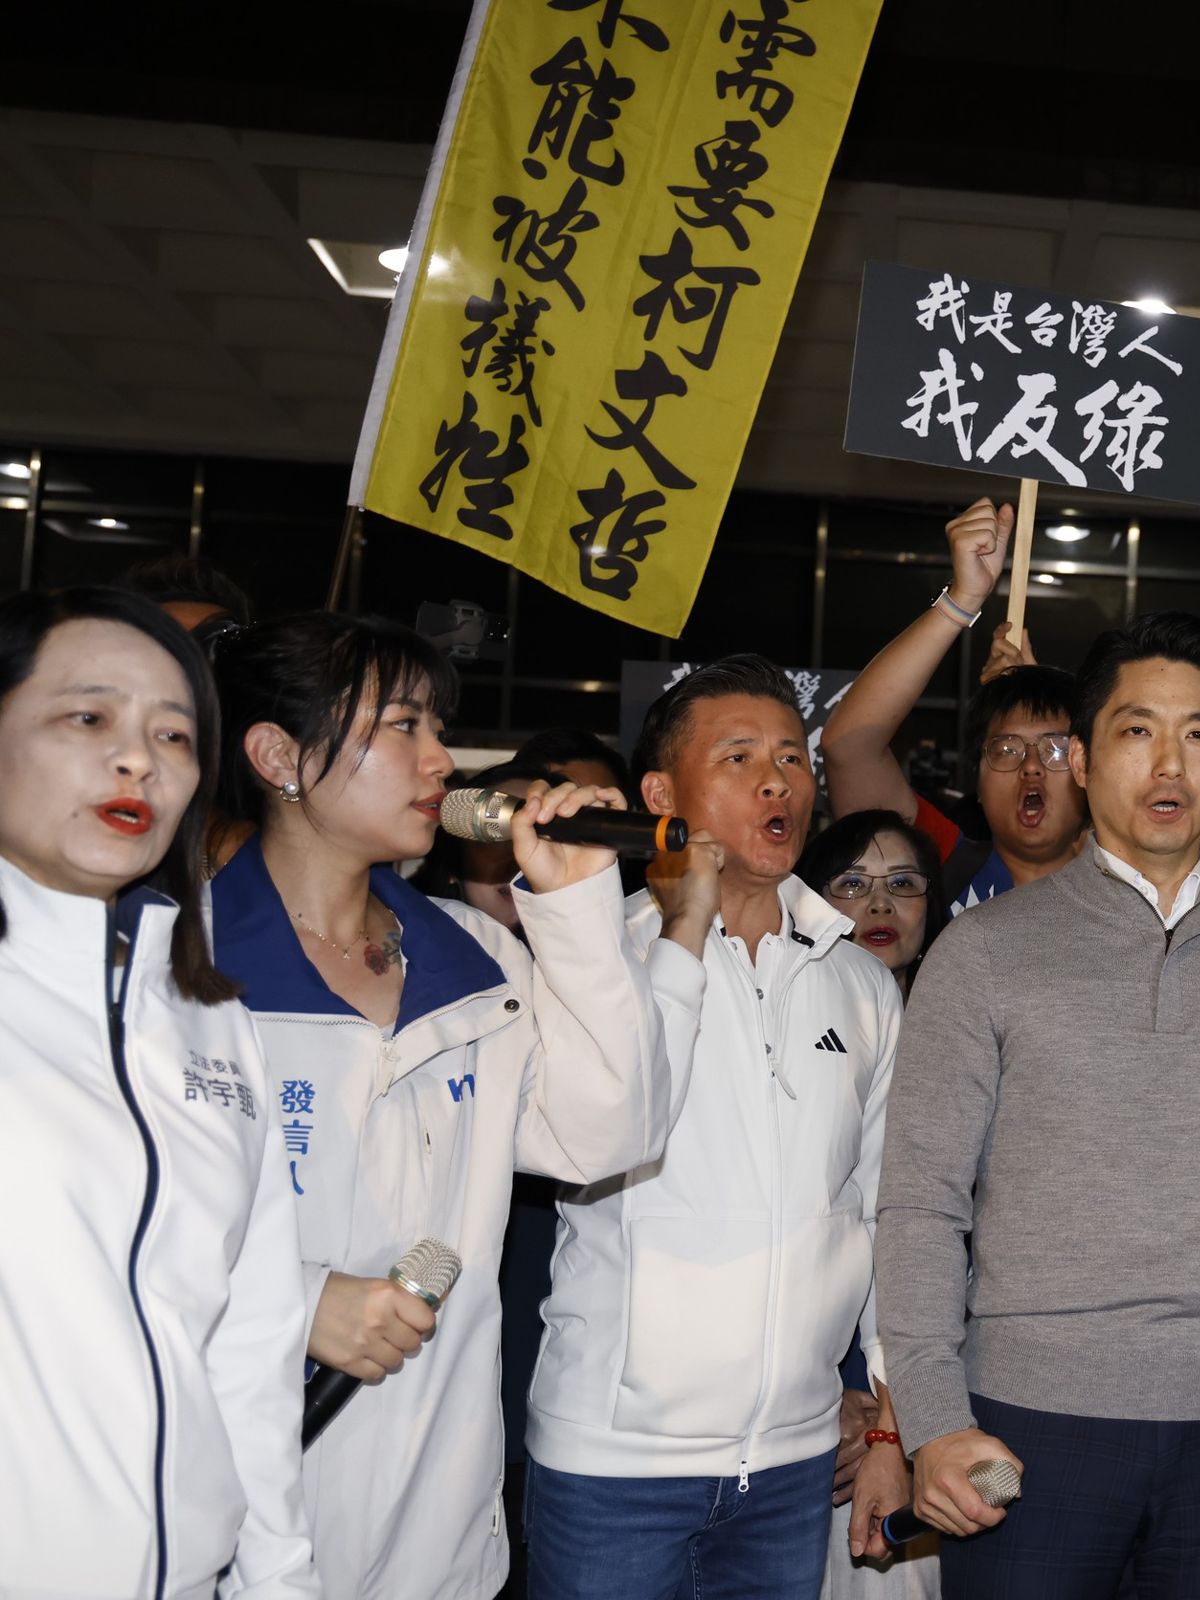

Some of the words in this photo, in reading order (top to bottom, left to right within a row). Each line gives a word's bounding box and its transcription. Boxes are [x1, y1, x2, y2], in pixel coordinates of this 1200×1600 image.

[915, 273, 1183, 376] 我是台灣人
[900, 348, 1169, 493] 我反綠
